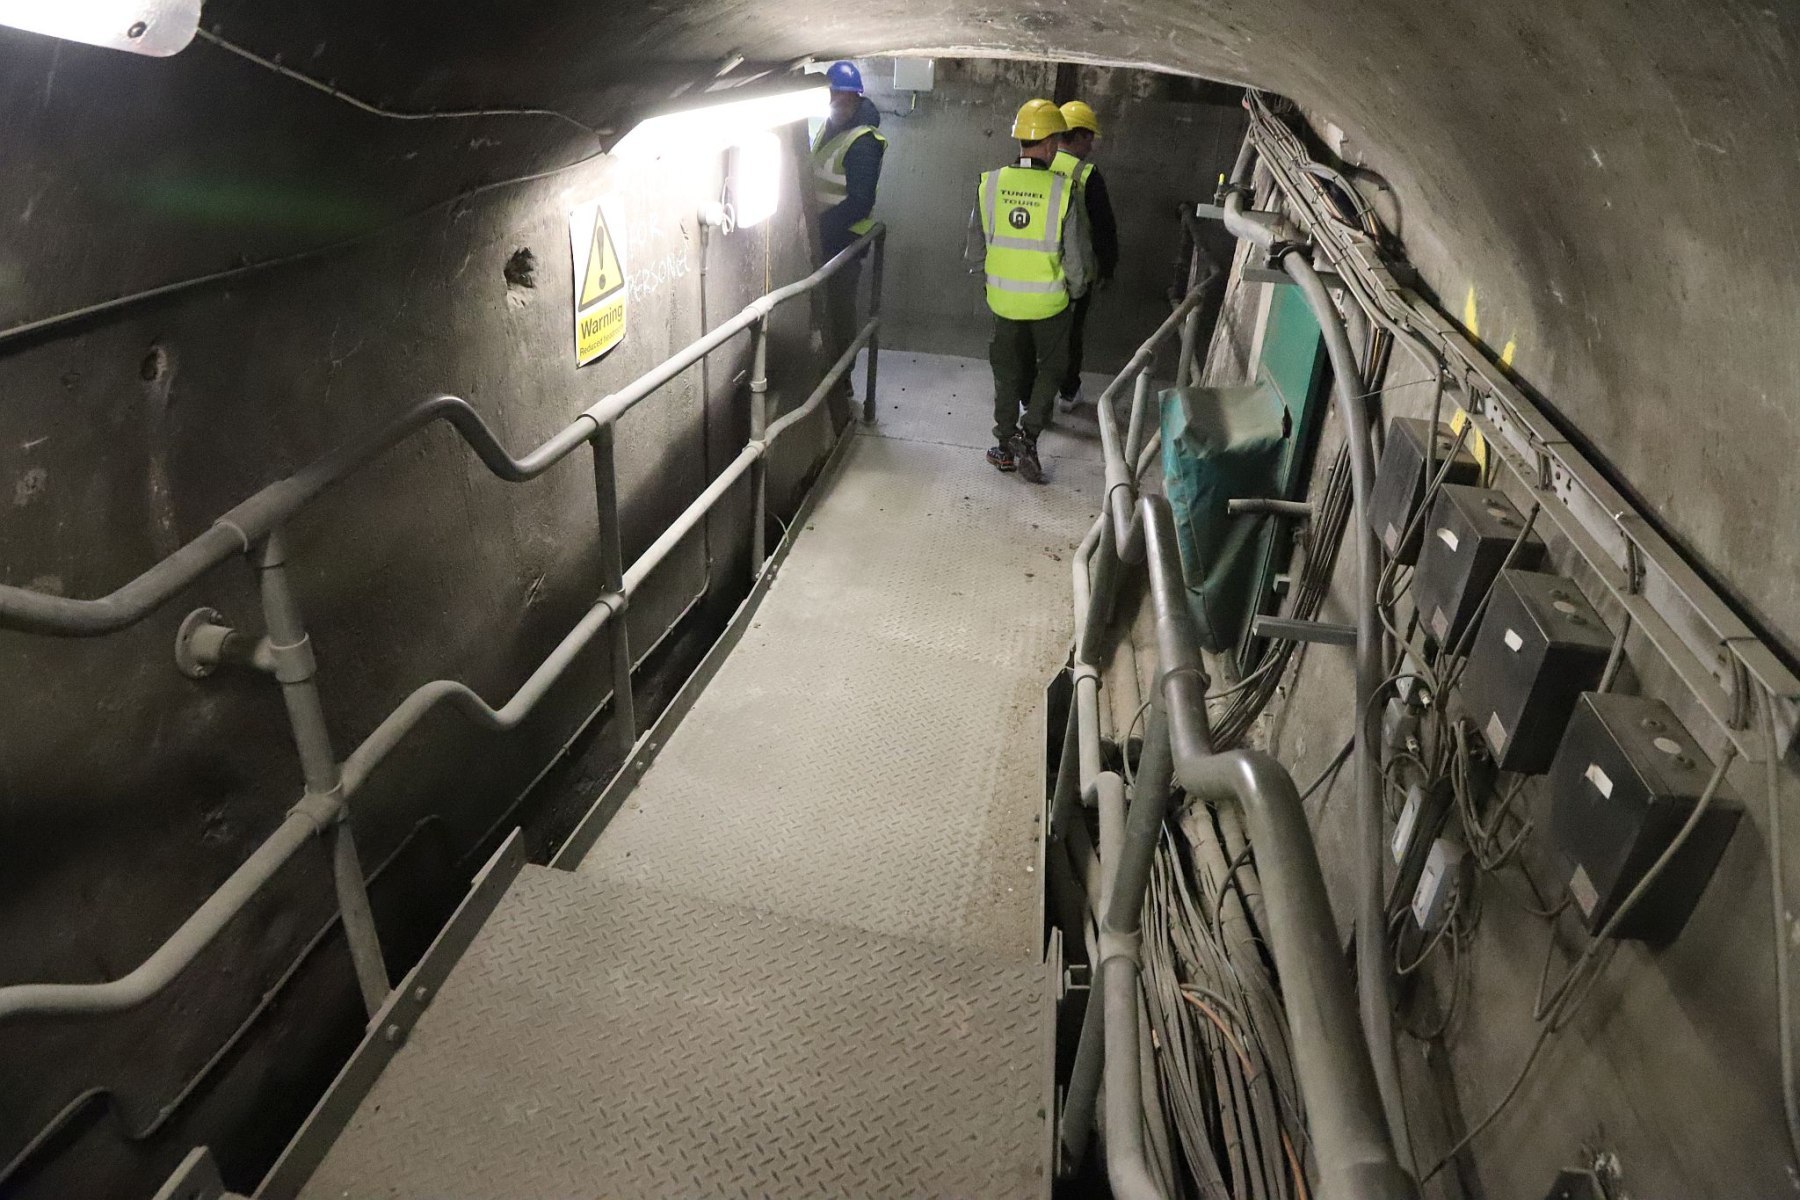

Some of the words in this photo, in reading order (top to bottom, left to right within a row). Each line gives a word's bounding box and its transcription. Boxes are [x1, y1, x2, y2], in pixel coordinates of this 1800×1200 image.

[1001, 189, 1045, 199] TUNNEL
[1003, 198, 1040, 207] TOURS
[581, 304, 623, 340] Warning
[580, 337, 603, 356] Reduced
